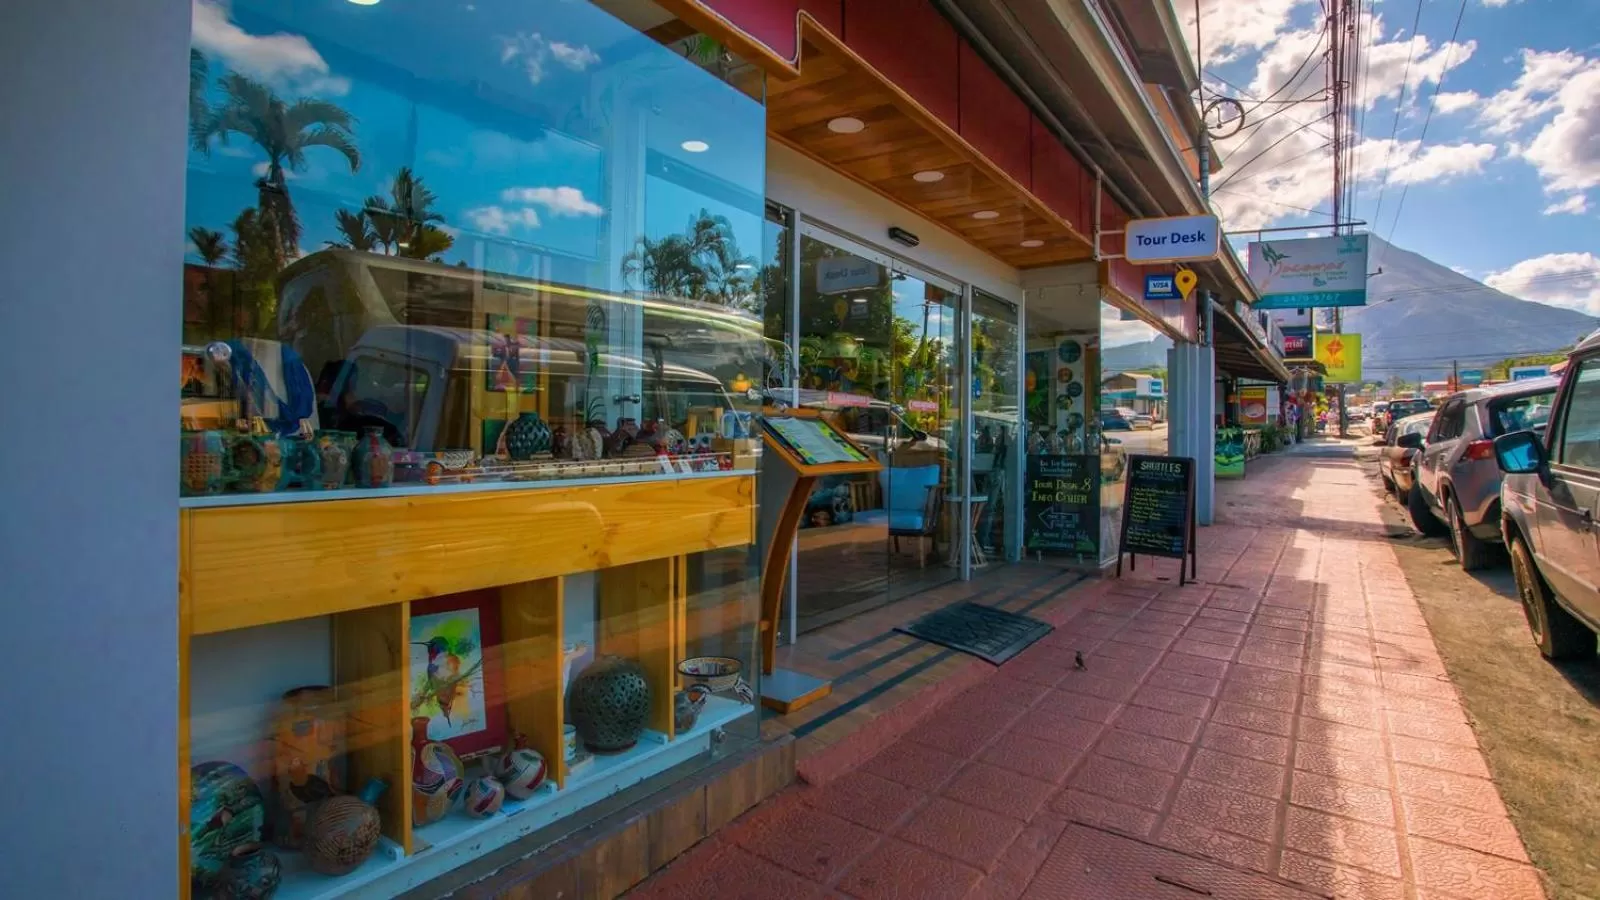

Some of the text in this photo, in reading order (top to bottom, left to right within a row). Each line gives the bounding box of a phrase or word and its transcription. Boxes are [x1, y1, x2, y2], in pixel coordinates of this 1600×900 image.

[1136, 230, 1206, 246] Tour Desk
[1141, 461, 1182, 473] SHUTTLES
